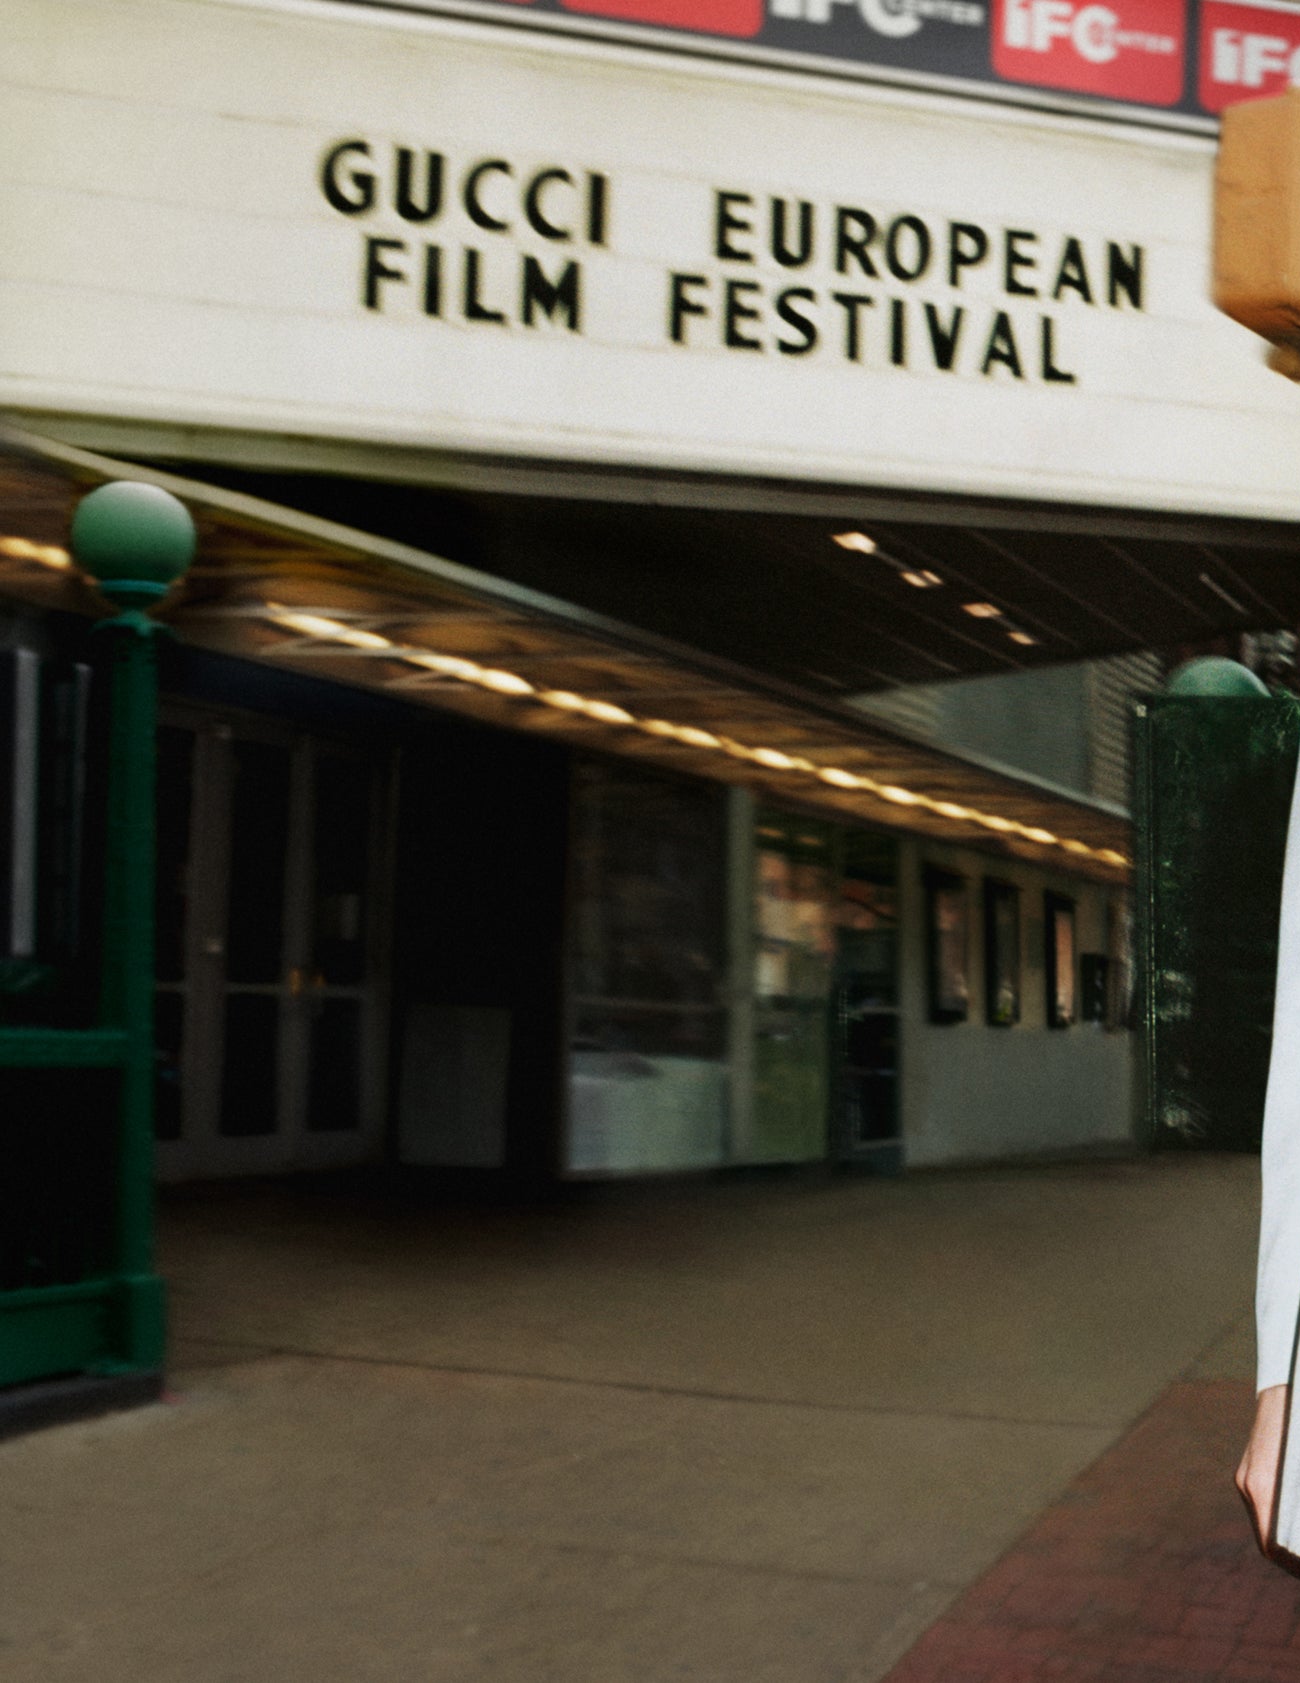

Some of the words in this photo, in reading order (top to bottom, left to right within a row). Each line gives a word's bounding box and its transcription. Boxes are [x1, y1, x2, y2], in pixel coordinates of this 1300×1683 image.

[320, 139, 608, 247] GUCCI
[714, 190, 1143, 310] EUROPEAN
[363, 236, 581, 332] FILM
[669, 272, 1076, 384] FESTIVAL
